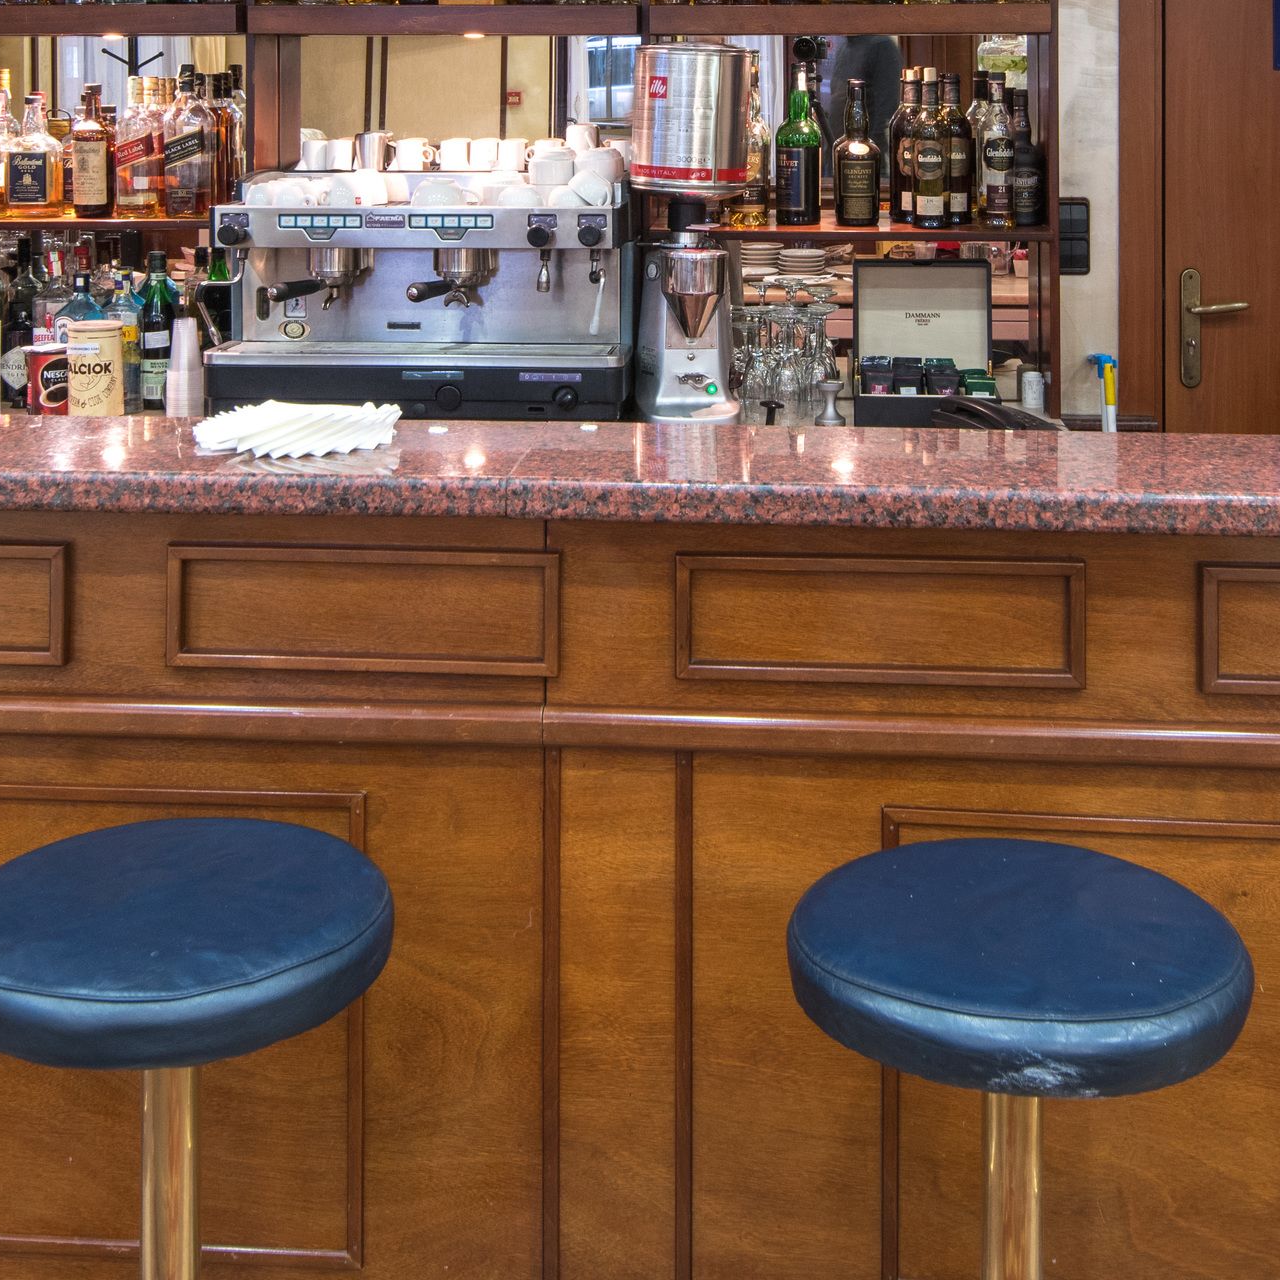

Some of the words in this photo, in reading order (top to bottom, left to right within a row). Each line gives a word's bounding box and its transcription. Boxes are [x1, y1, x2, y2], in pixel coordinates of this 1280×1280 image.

[649, 79, 667, 98] illy
[117, 149, 129, 159] Red
[129, 143, 145, 155] Label
[165, 146, 181, 156] BLACK
[181, 139, 200, 149] LABEL
[986, 148, 1014, 158] Glenfiddich
[917, 154, 942, 164] Glenfiddich
[34, 334, 55, 343] BEEFEA
[43, 370, 68, 380] NESCA
